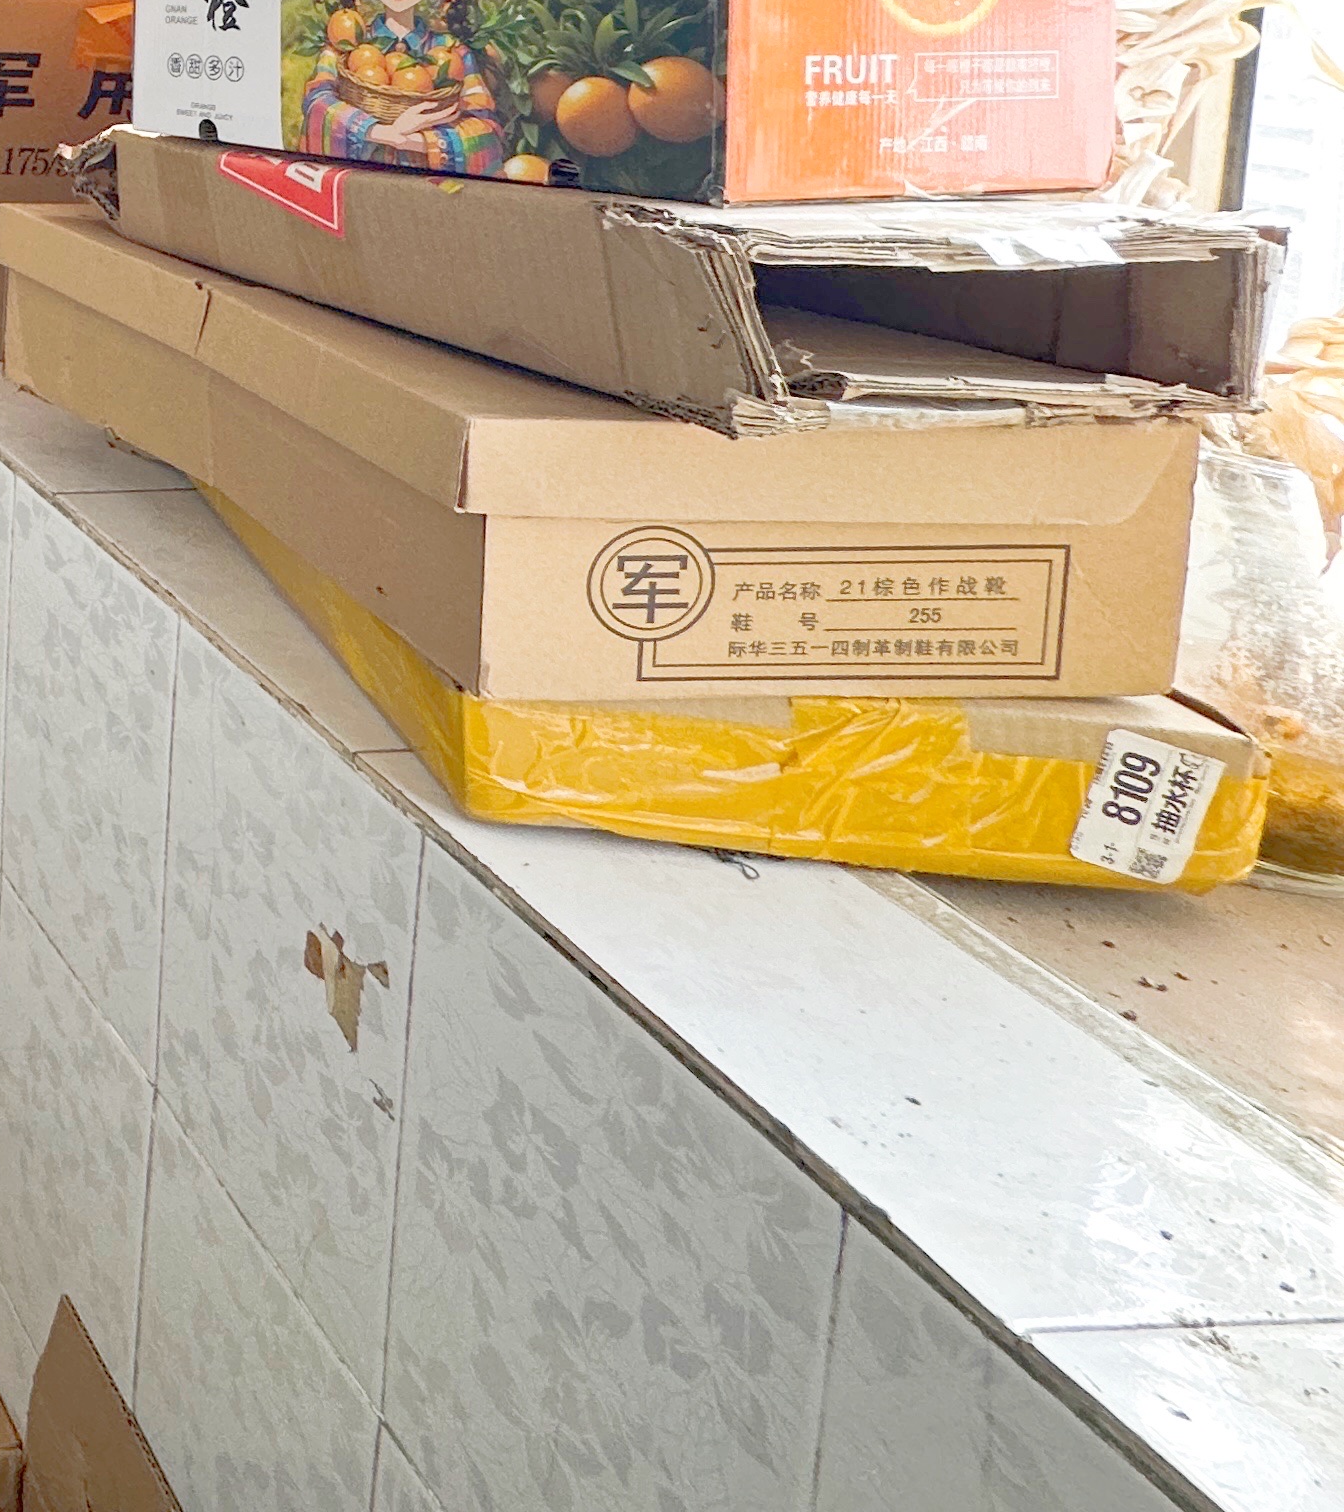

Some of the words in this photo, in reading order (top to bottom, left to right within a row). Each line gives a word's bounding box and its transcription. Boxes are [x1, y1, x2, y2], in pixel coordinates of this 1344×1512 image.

[805, 54, 898, 85] FRUIT
[612, 554, 690, 624] 军
[732, 580, 821, 603] 产品名称
[909, 606, 942, 625] 255
[727, 638, 1020, 658] 际华三五一四制革制鞋有限公司
[1101, 751, 1161, 826] 8109
